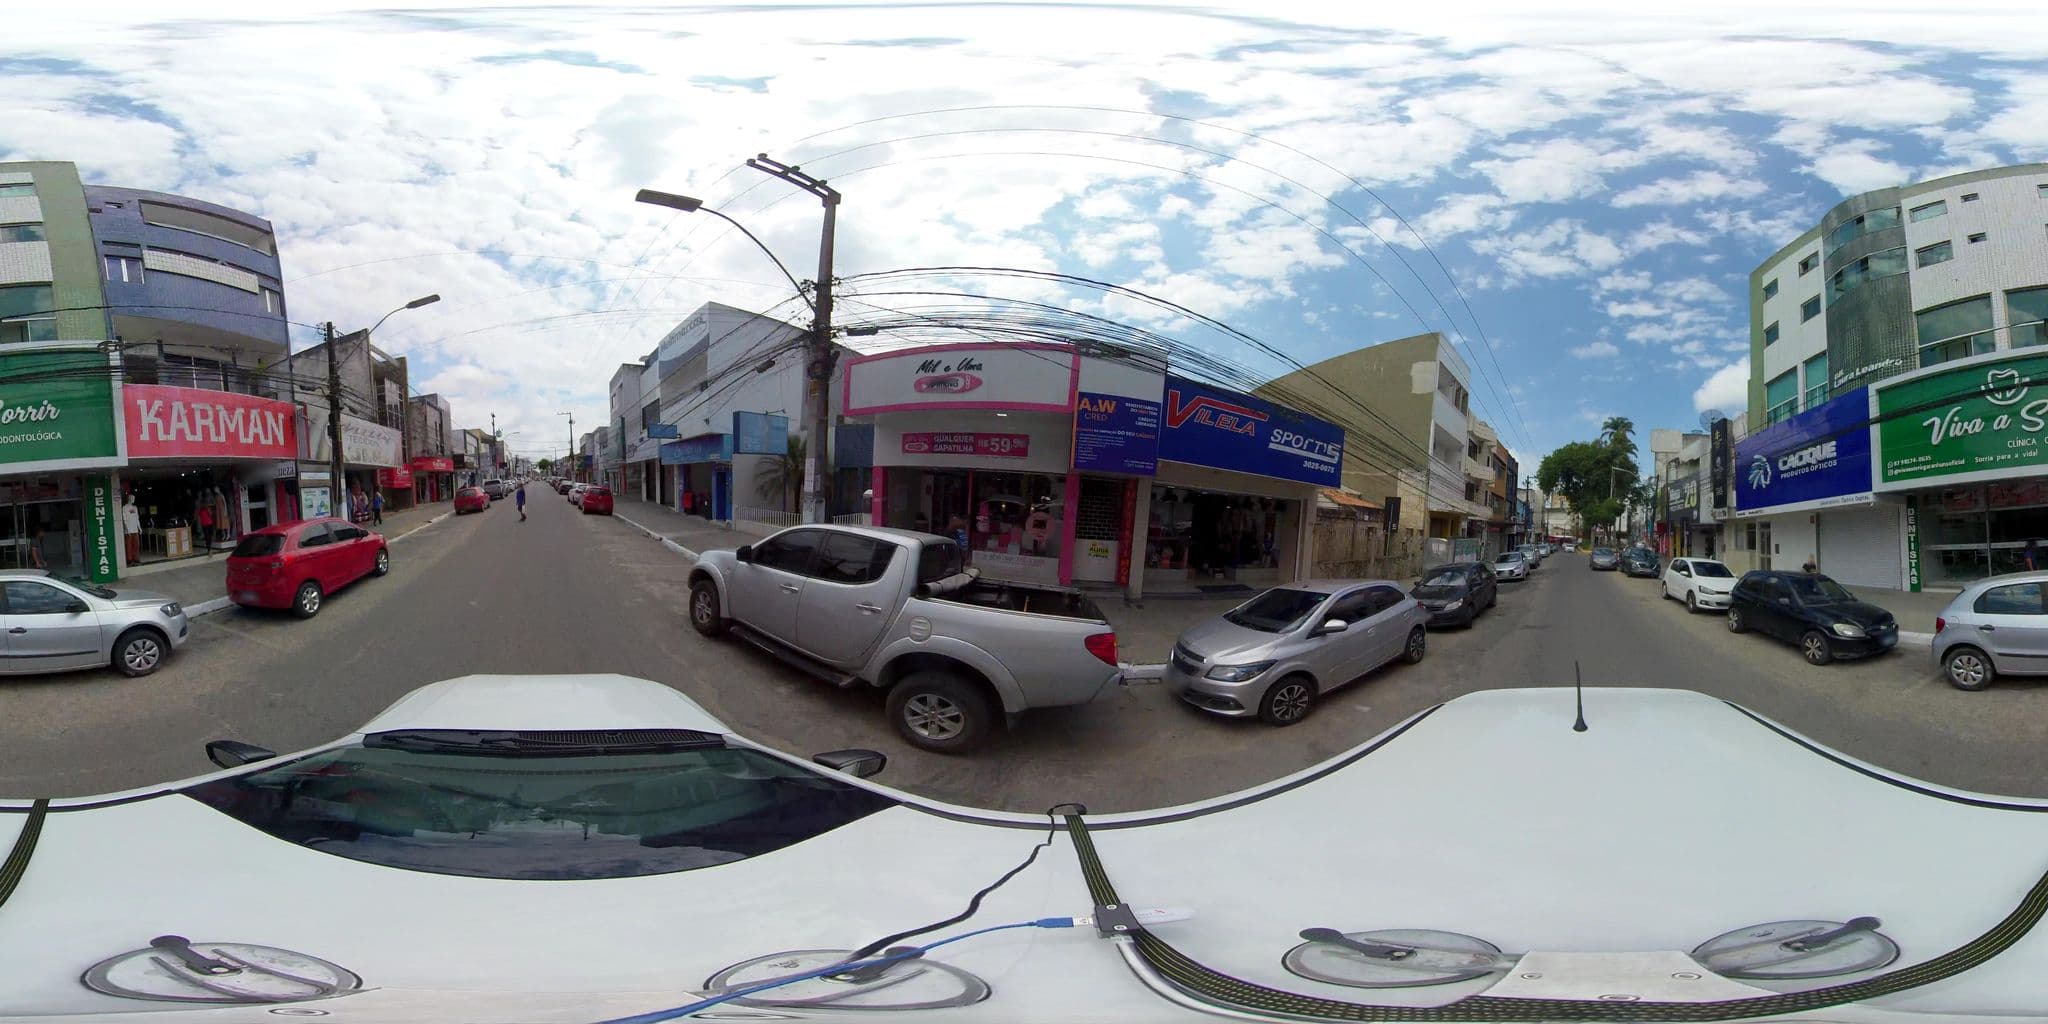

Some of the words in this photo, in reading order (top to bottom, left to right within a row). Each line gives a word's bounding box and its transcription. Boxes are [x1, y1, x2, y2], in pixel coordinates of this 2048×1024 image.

[916, 360, 941, 374] Mil
[957, 358, 983, 371] Uma
[1856, 359, 1903, 376] Leandro
[0, 400, 60, 424] orrir
[137, 400, 285, 446] KARMAN
[1085, 412, 1107, 421] CRED
[1167, 389, 1270, 436] VILELA
[1923, 406, 1984, 445] Viva
[1993, 414, 2012, 430] a
[933, 444, 974, 452] SAPATILHA
[1778, 440, 1837, 471] CACIQUE
[2007, 436, 2037, 448] CLÍNICA
[94, 488, 109, 575] DENTISTAS
[1907, 508, 1917, 585] DENTISTAS
